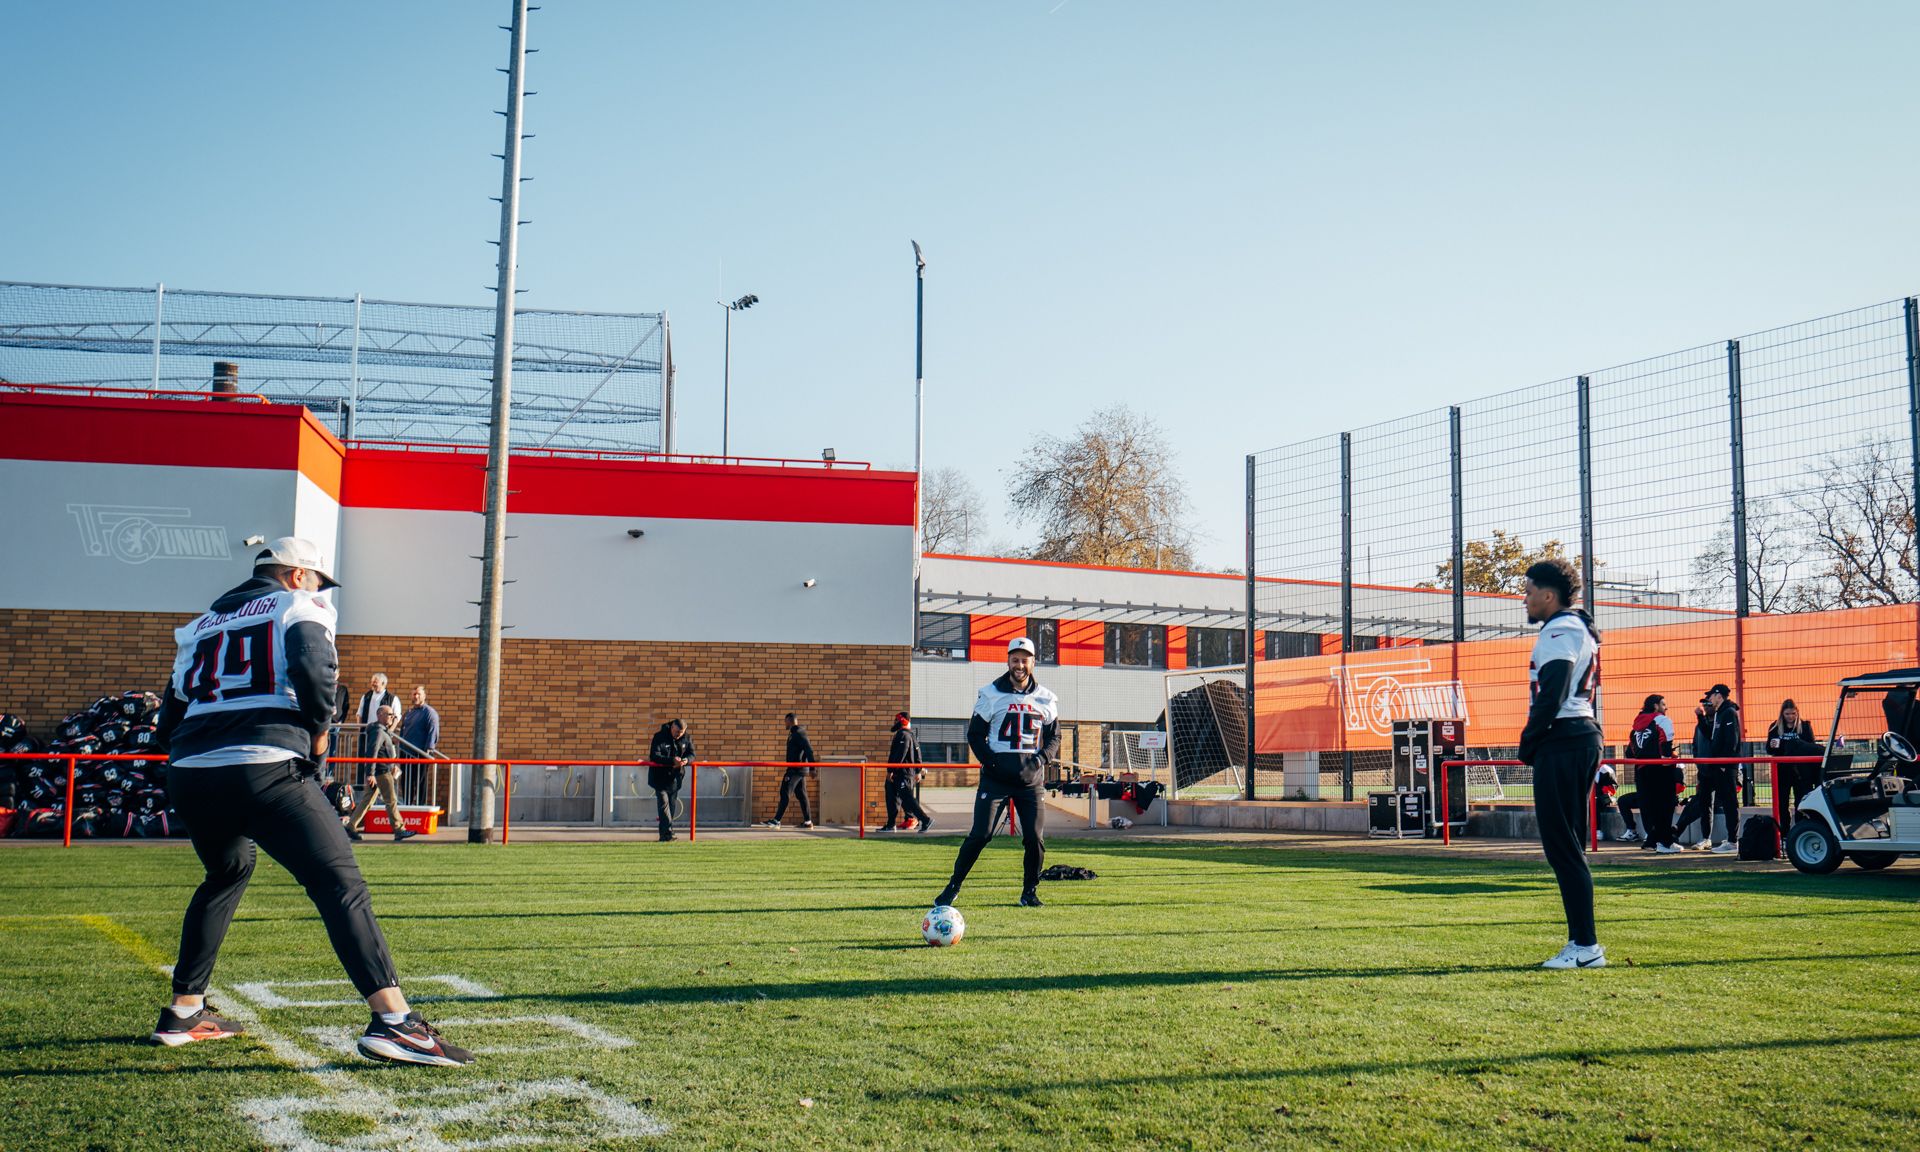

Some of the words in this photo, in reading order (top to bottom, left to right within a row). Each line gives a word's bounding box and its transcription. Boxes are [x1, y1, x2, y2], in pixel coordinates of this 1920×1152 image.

[160, 528, 228, 556] UNION
[182, 619, 275, 704] 49
[123, 703, 135, 715] 89
[1007, 703, 1035, 712] ATL
[1405, 685, 1465, 720] UNION
[137, 732, 150, 743] 80
[998, 712, 1044, 750] 45
[373, 816, 422, 826] GATADE
